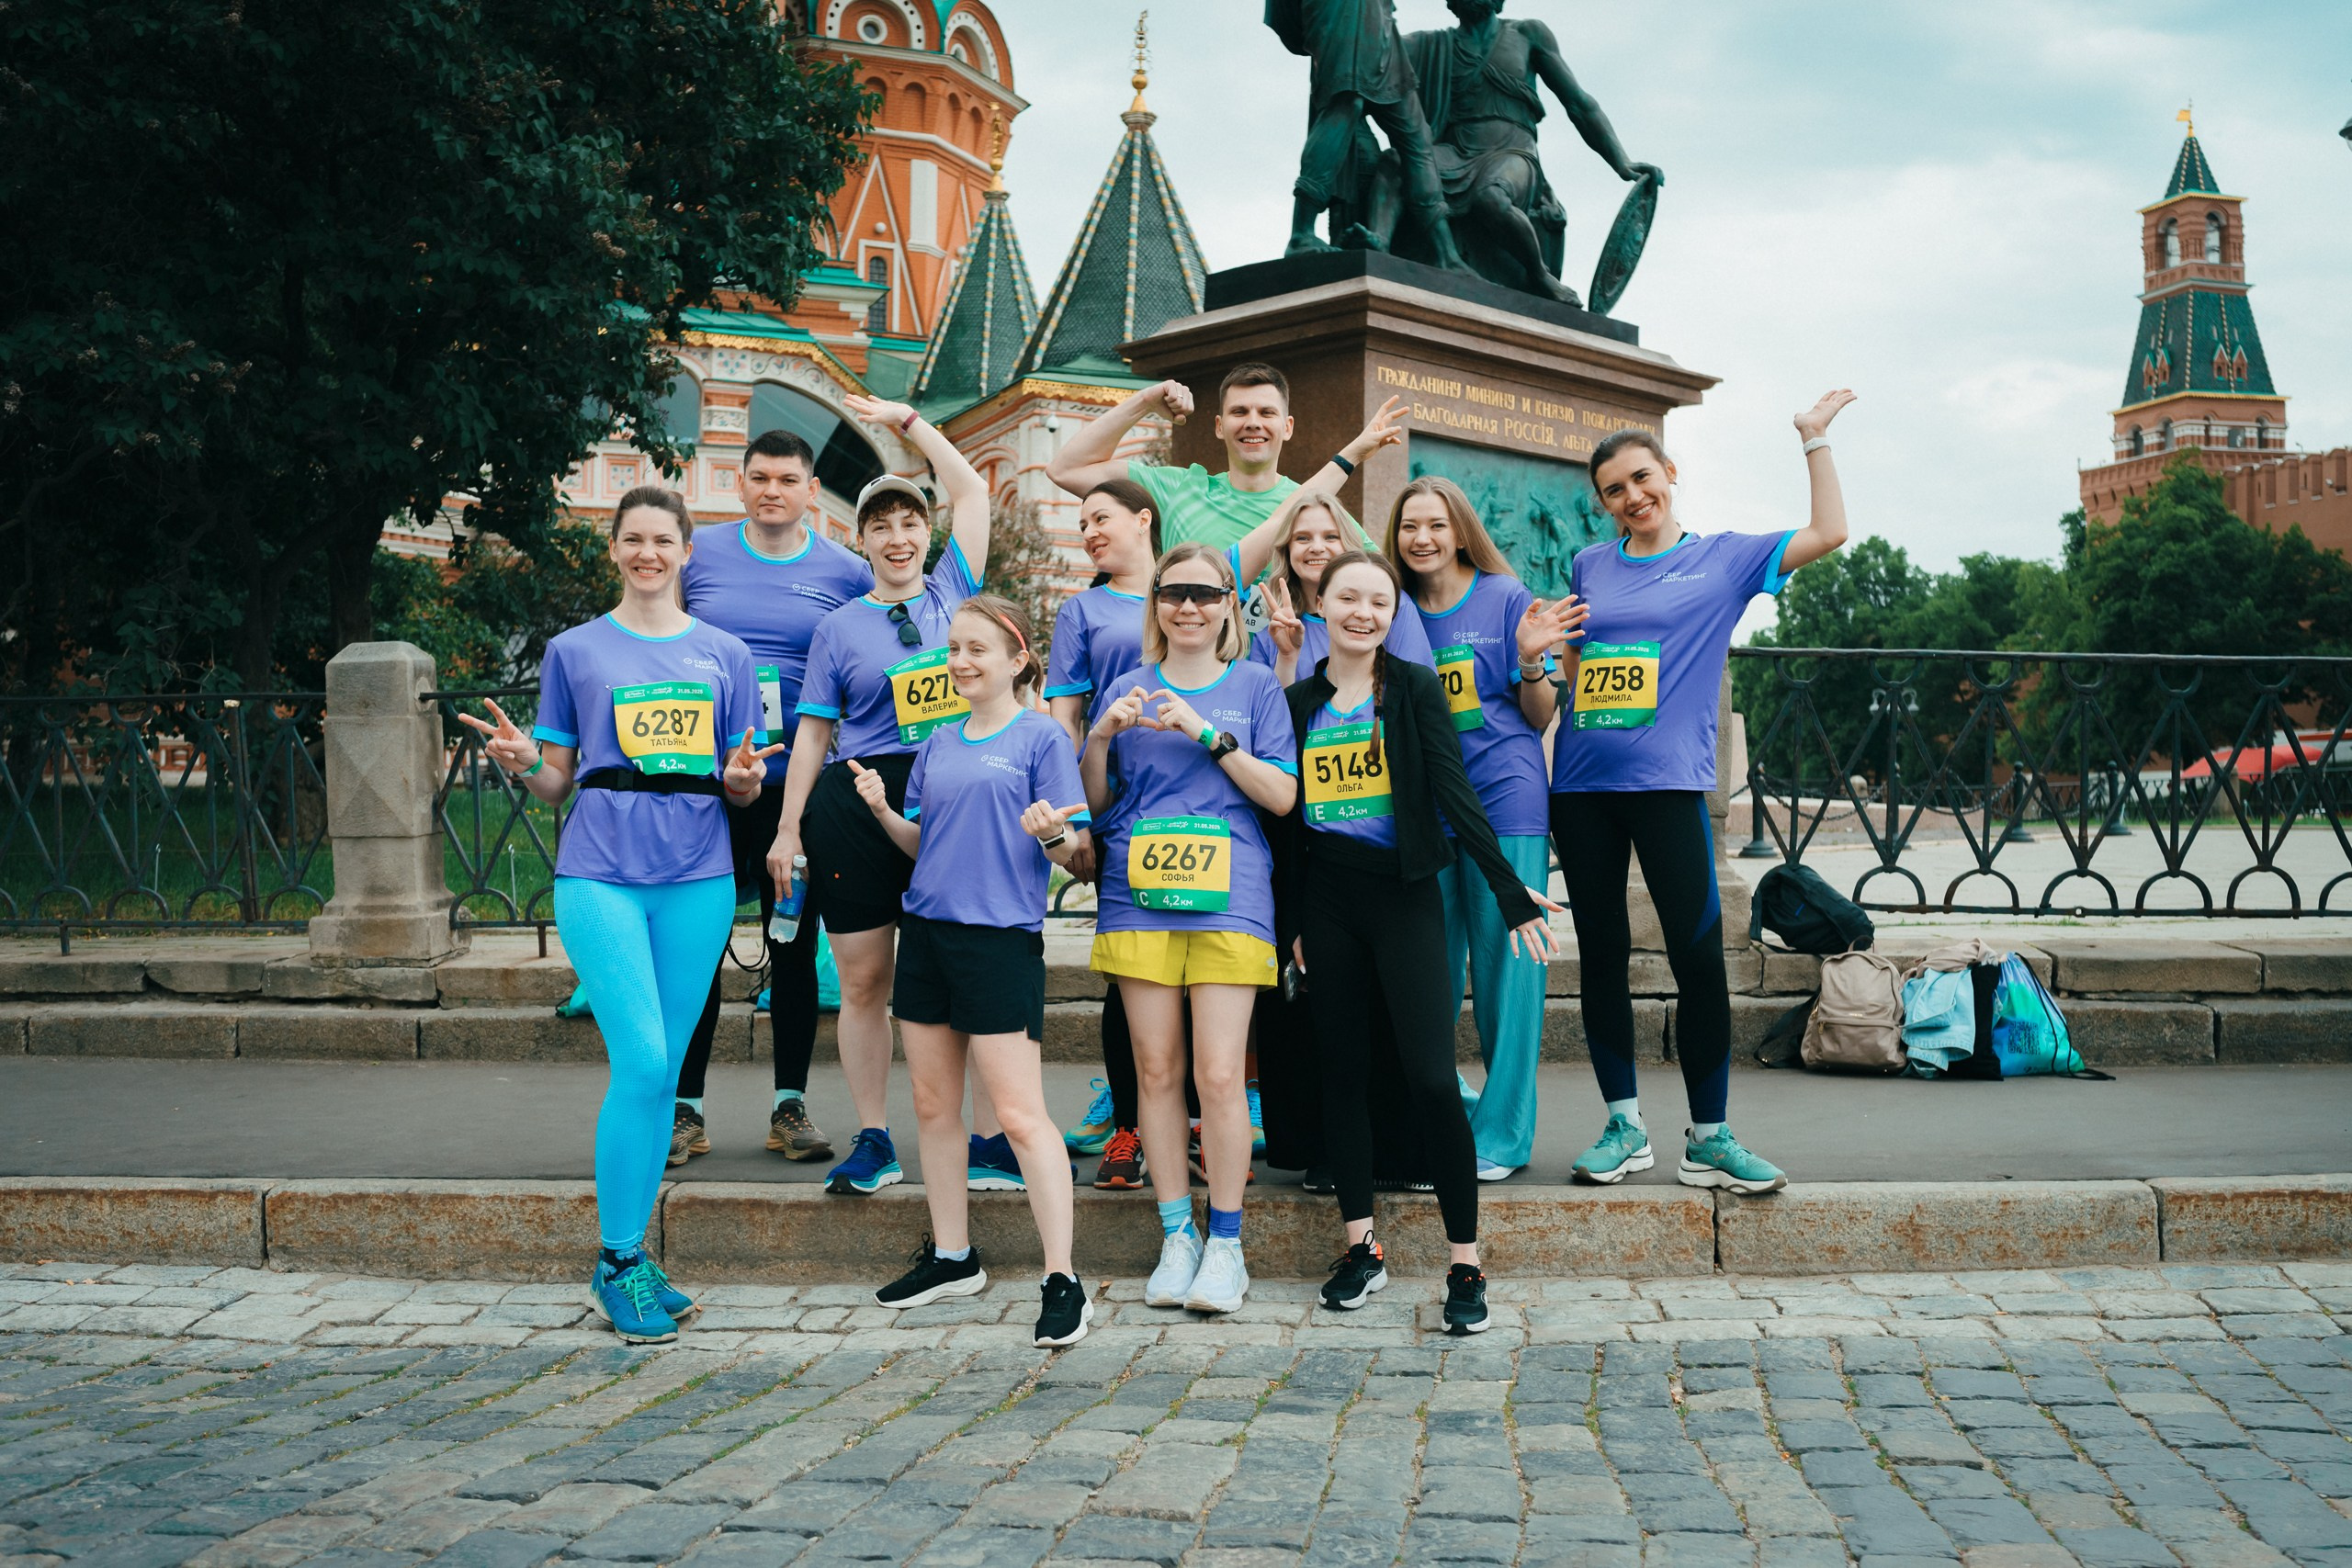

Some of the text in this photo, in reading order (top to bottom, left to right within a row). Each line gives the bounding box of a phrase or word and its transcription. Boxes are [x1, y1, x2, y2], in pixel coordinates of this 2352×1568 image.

[1377, 367, 1461, 399] ГРАЖДАНИНУ
[1465, 384, 1515, 411] МИНИНУ
[1521, 397, 1531, 413] И
[1534, 400, 1575, 423] КНЯЗЮ
[1413, 402, 1498, 434] БЛАГОДАРНАЯ
[1661, 572, 1707, 583] МАРКЕТИНГ
[1583, 665, 1644, 694] 2758
[1590, 694, 1632, 704] ЛЮДМИЛА
[922, 700, 958, 714] ВАЛЕРИЯ
[632, 708, 700, 737] 6287
[650, 738, 687, 747] ТАТЬЯНА
[989, 755, 1009, 763] СБЕР
[1315, 750, 1383, 784] 5148
[1337, 783, 1363, 793] ОЛЬГА
[1142, 843, 1217, 872] 6267
[1161, 874, 1194, 882] СОФЬЯ
